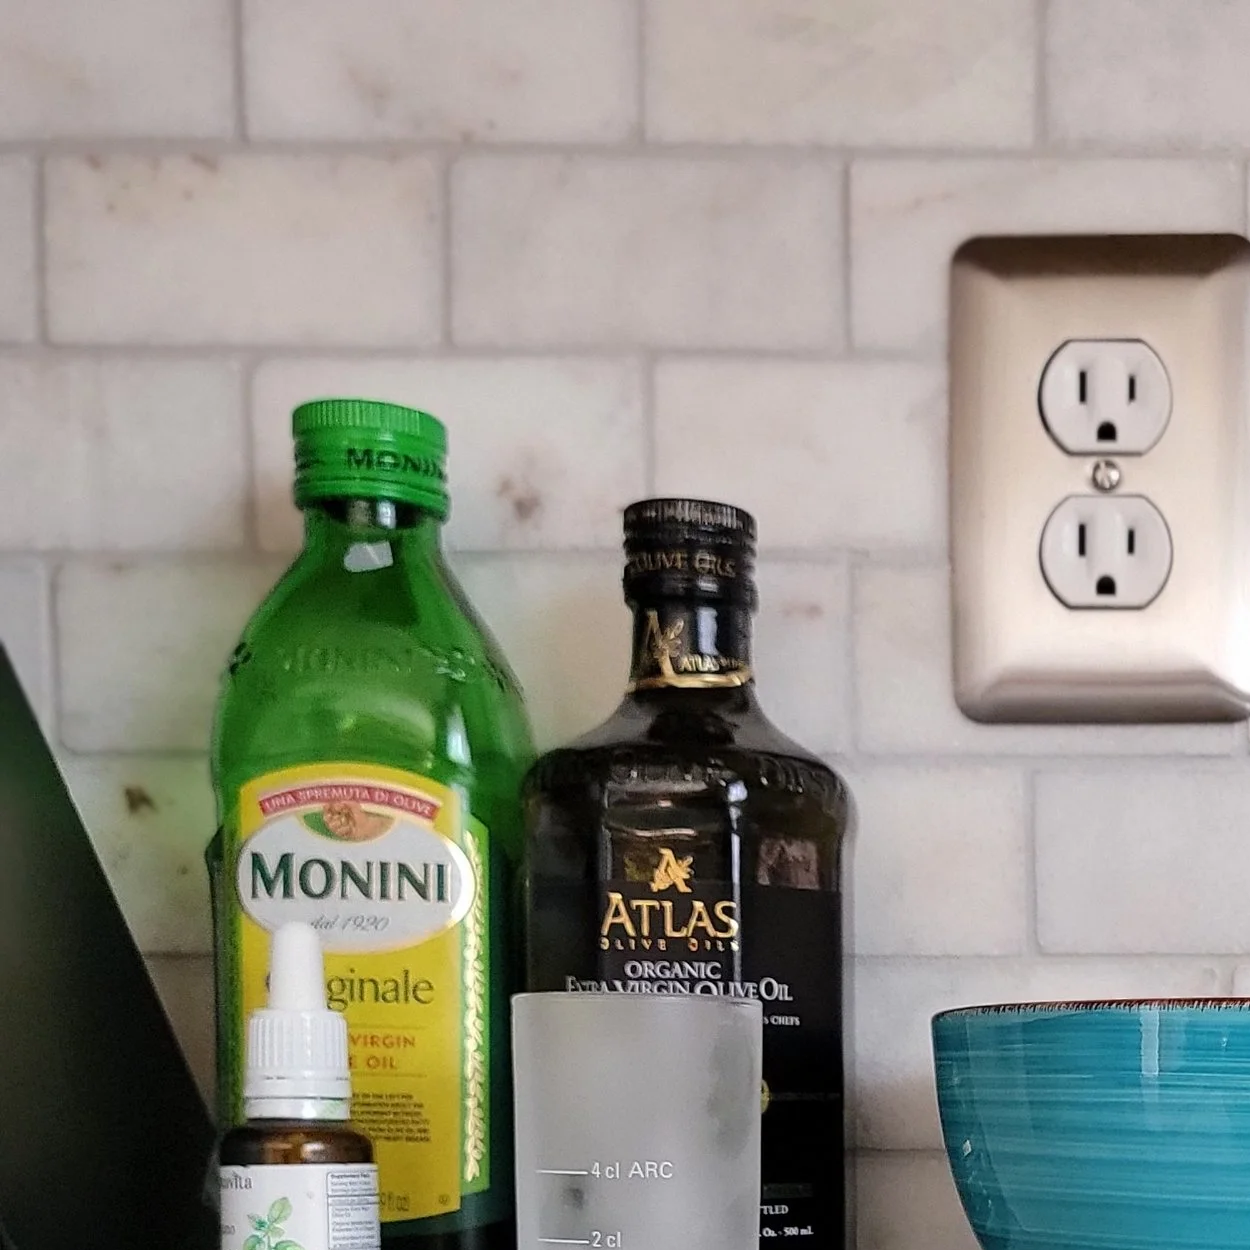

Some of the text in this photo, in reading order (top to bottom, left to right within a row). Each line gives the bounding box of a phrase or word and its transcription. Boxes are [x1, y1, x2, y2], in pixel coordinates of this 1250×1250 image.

[265, 785, 432, 816] UNA SPREMUTA DI OLIVE
[250, 851, 451, 903] MONINI
[600, 891, 740, 939] ATLAS
[600, 936, 740, 951] OLIVE OILS
[623, 959, 723, 980] ORGANIC
[326, 967, 436, 1013] ginale
[611, 980, 691, 994] VIRGIN
[694, 980, 758, 998] OLIVE
[758, 976, 794, 1002] OIL
[770, 1014, 800, 1027] CHEFS
[348, 1033, 416, 1049] VIRGIN
[366, 1055, 397, 1069] OIL
[590, 1160, 674, 1179] 4 cl ARC
[760, 1204, 790, 1216] TLED
[590, 1231, 622, 1248] 2 cl
[783, 1226, 799, 1237] 500
